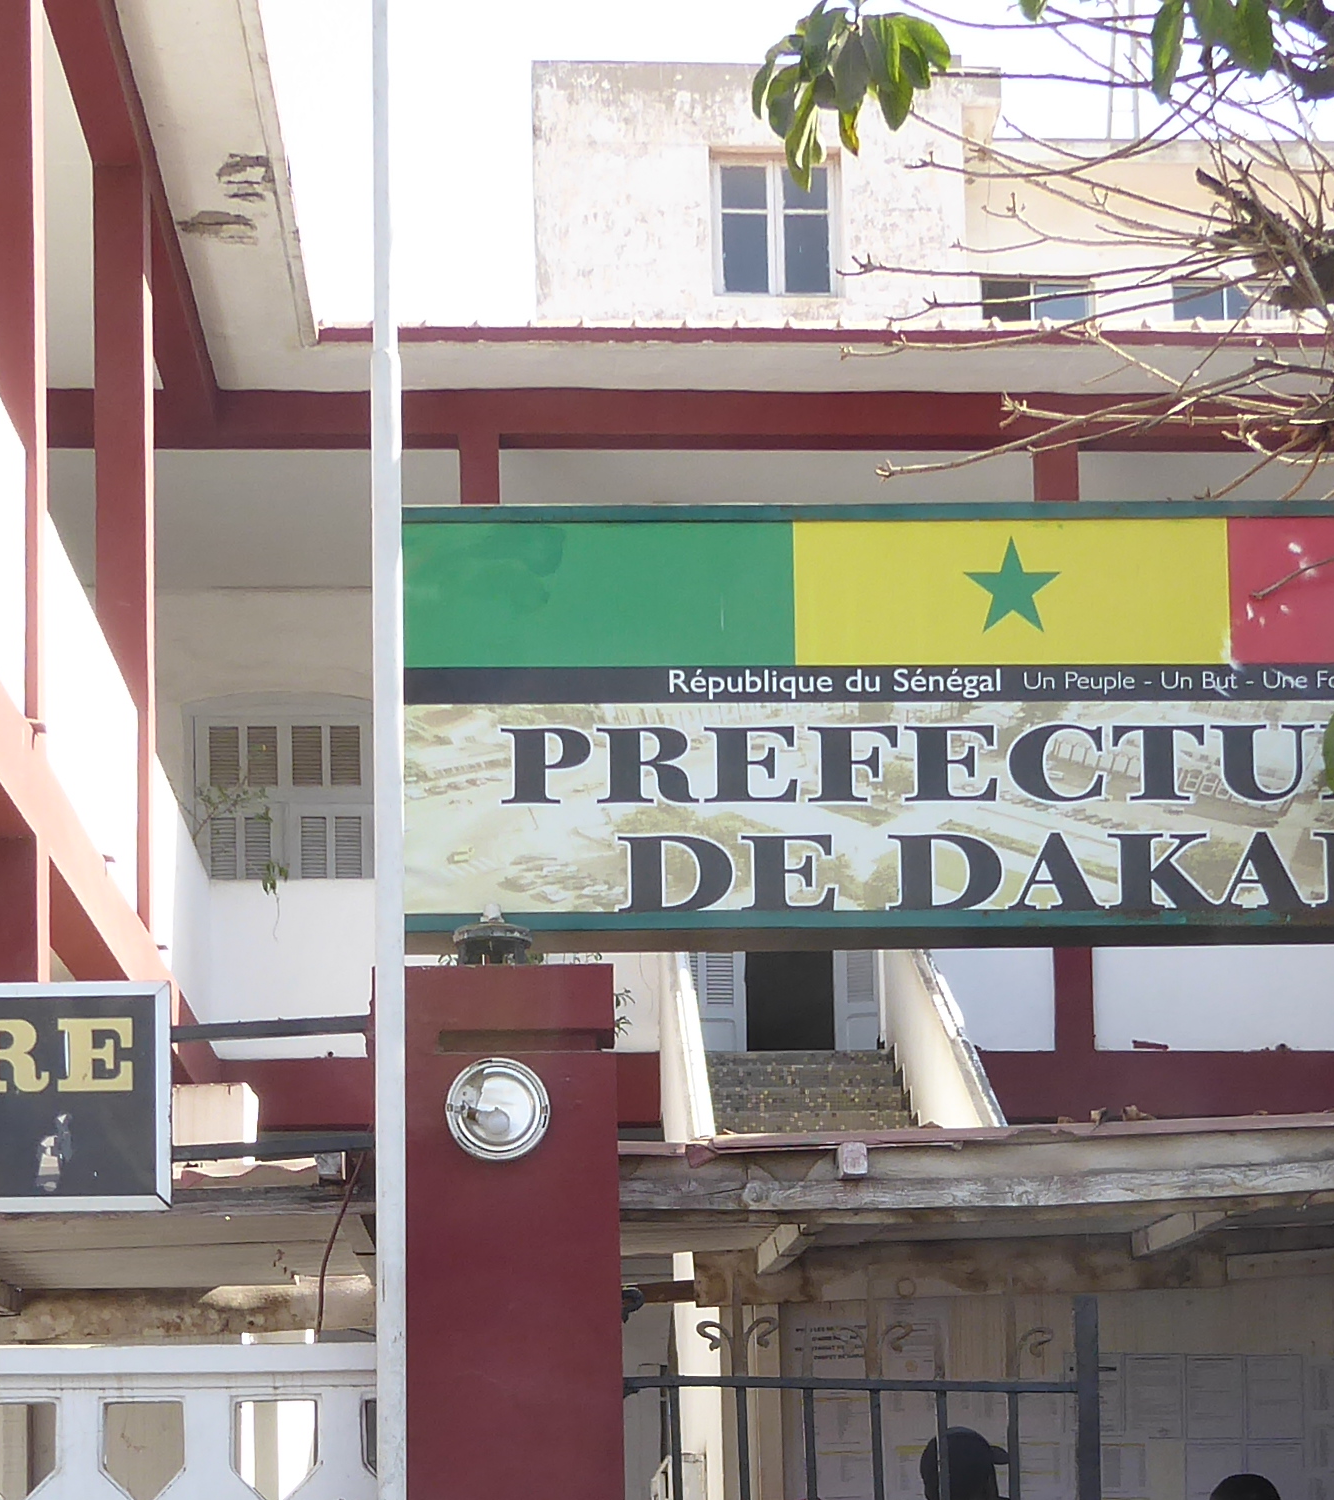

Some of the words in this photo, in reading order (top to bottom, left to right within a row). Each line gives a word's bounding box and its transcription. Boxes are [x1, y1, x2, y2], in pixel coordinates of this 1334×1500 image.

[668, 668, 834, 699] République
[845, 668, 881, 692] du
[893, 667, 1002, 699] Sénégal
[1023, 671, 1055, 690] Un
[1064, 671, 1136, 695] Peuple
[1160, 671, 1193, 691] Un
[1204, 671, 1238, 691] But
[1262, 670, 1308, 690] Une
[615, 832, 840, 911] DE
